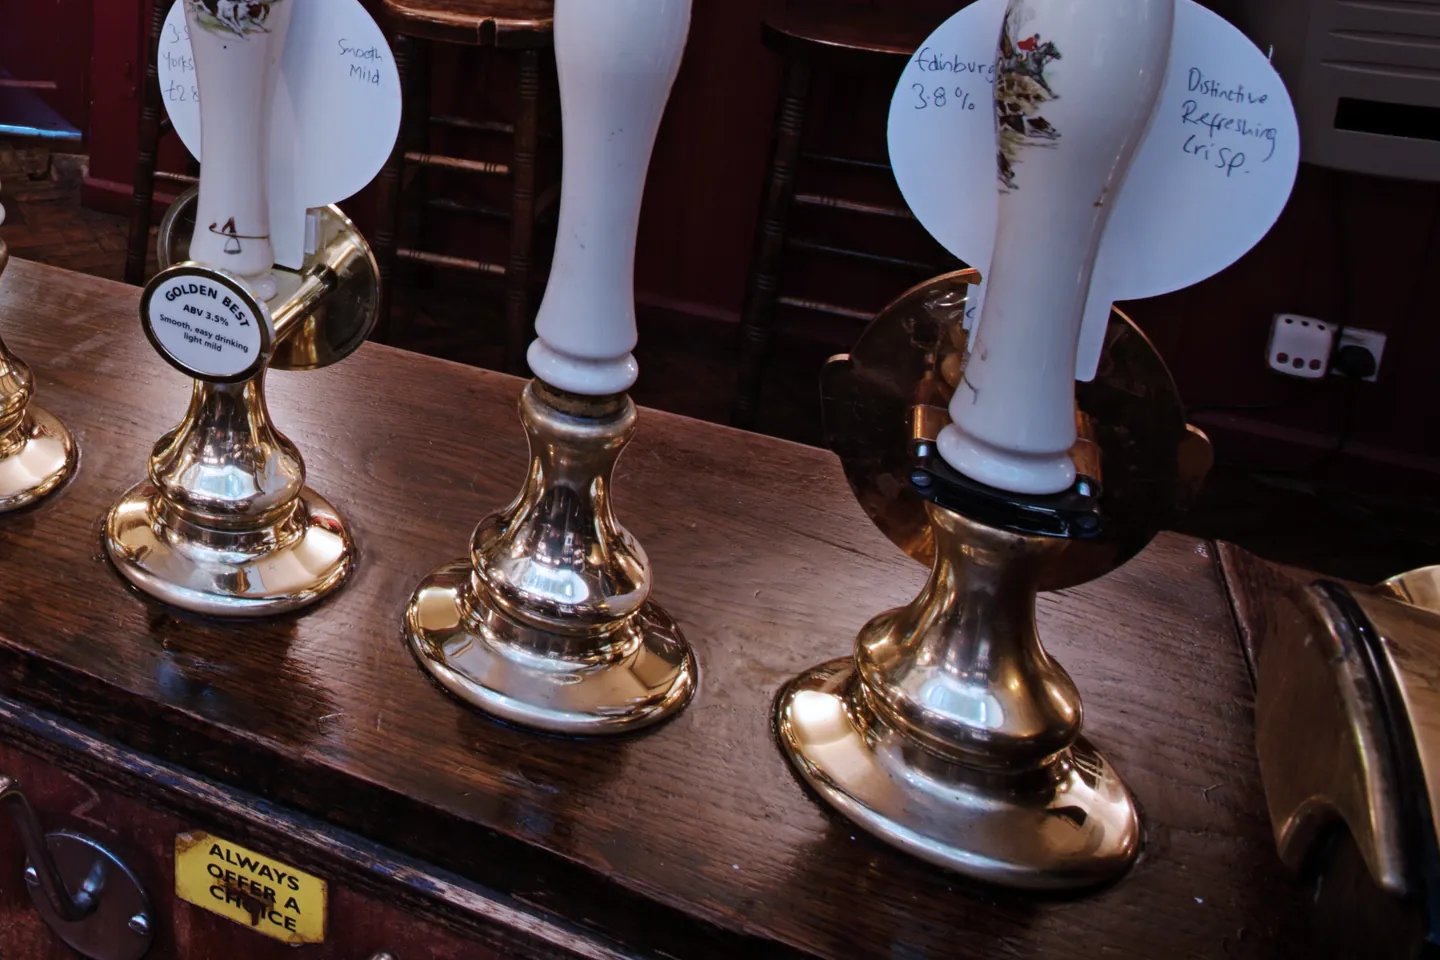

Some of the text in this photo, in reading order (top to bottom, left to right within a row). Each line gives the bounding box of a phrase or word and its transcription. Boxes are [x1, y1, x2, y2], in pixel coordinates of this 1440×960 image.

[338, 38, 383, 62] Smooth
[349, 63, 380, 85] Mild
[1188, 67, 1268, 104] Distinctive
[1182, 100, 1277, 163] Refreshing
[165, 283, 250, 328] GOLDEN BEST
[183, 304, 229, 326] ABV 3.5%
[160, 314, 249, 353] Smooth, easy drinking
[183, 332, 222, 352] light mild
[209, 843, 300, 891] ALWAYS
[206, 863, 301, 915] OFFER A
